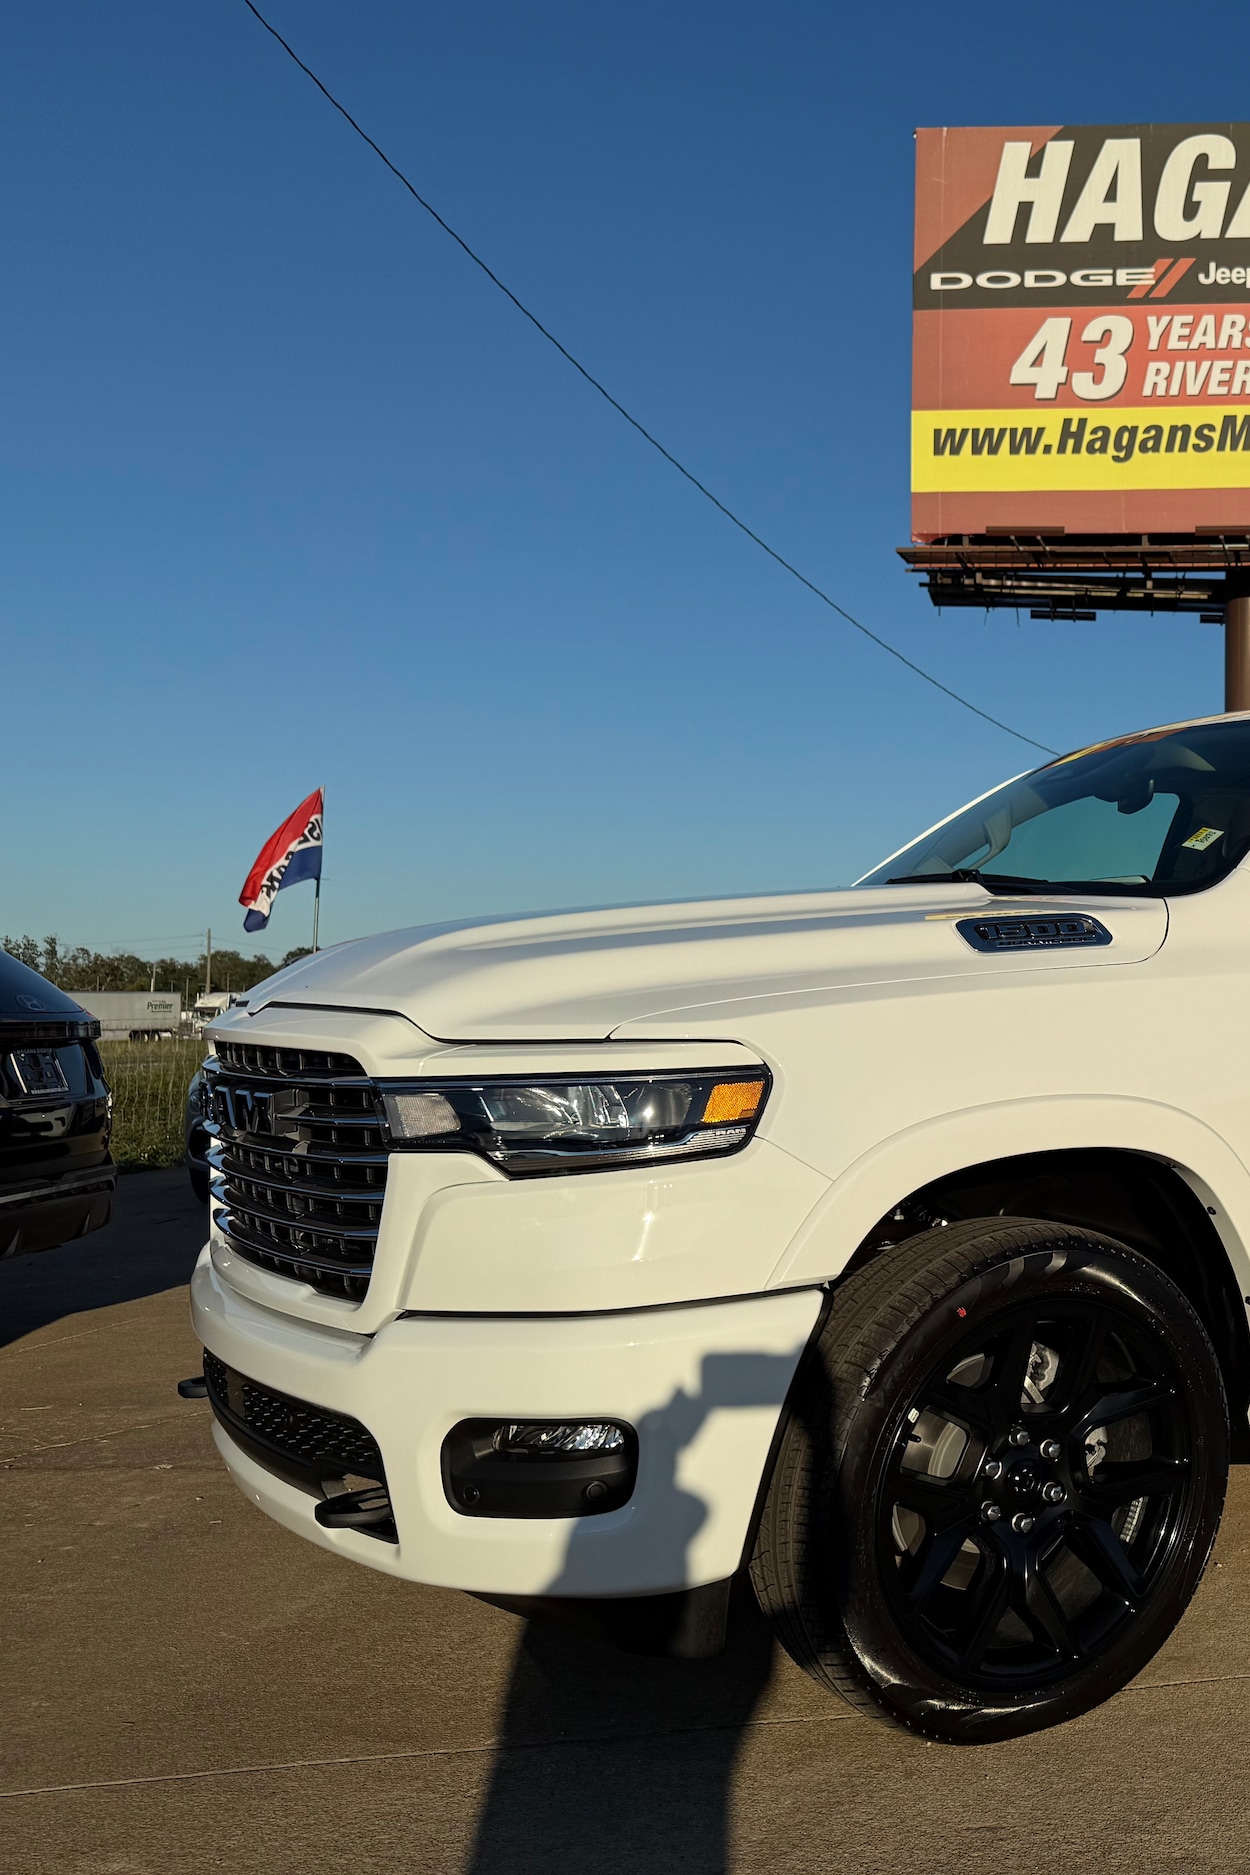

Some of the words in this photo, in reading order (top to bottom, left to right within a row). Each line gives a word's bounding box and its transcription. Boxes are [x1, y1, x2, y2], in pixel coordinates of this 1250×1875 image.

[930, 267, 1156, 290] DODGE
[1009, 315, 1135, 401] 43
[979, 920, 1088, 941] 1500
[146, 1001, 174, 1011] Premier
[715, 1127, 747, 1136] RAM
